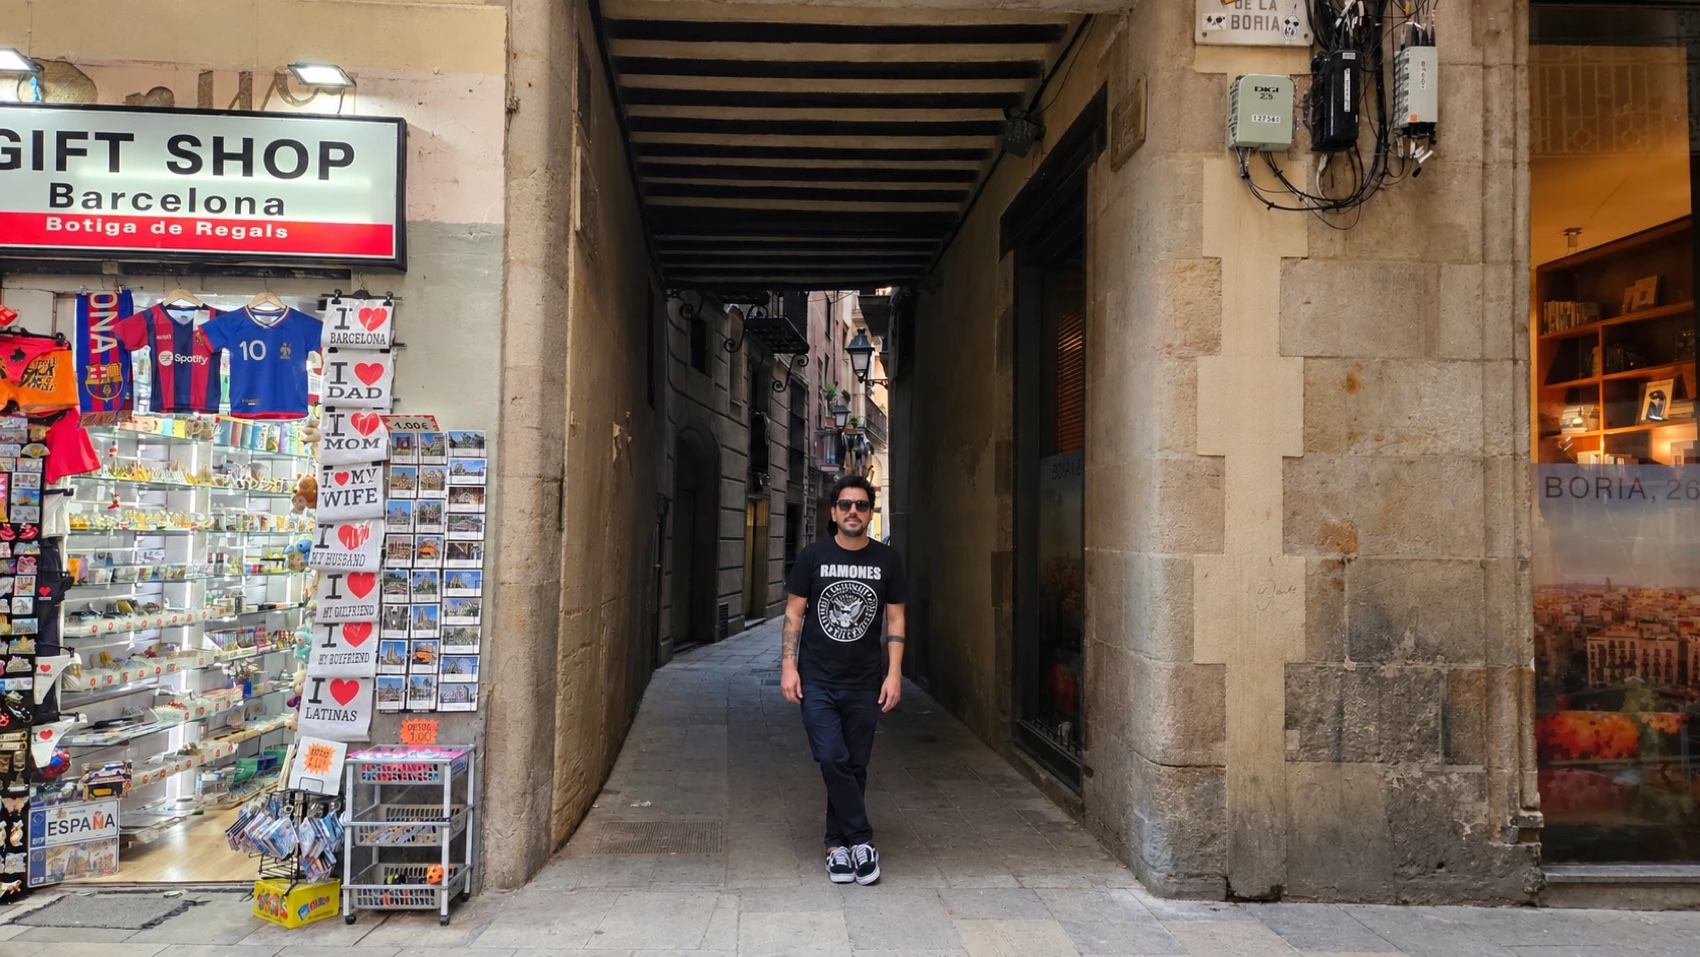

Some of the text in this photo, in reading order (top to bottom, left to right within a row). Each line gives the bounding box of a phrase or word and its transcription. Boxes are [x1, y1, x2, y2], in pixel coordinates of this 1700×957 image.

[1259, 0, 1277, 11] LA
[166, 134, 356, 180] SHOP
[49, 182, 285, 216] Barcelona
[46, 217, 288, 240] Botiga de Regals
[334, 307, 353, 330] I
[239, 339, 267, 361] 10
[330, 332, 386, 345] BARCELONA
[174, 353, 208, 365] Spotify
[329, 361, 348, 385] I
[327, 386, 383, 399] DAD
[326, 413, 345, 437] I
[324, 437, 381, 450] MOM
[351, 468, 378, 485] MY
[321, 487, 378, 508] WIFE
[1545, 476, 1700, 504] BORIA, 26
[314, 523, 335, 549] I
[820, 564, 882, 580] RAMONES
[325, 574, 343, 600] I
[321, 623, 339, 648] I
[308, 677, 326, 704] I
[305, 707, 358, 722] LATINAS
[48, 811, 115, 837] ESPAÑA
